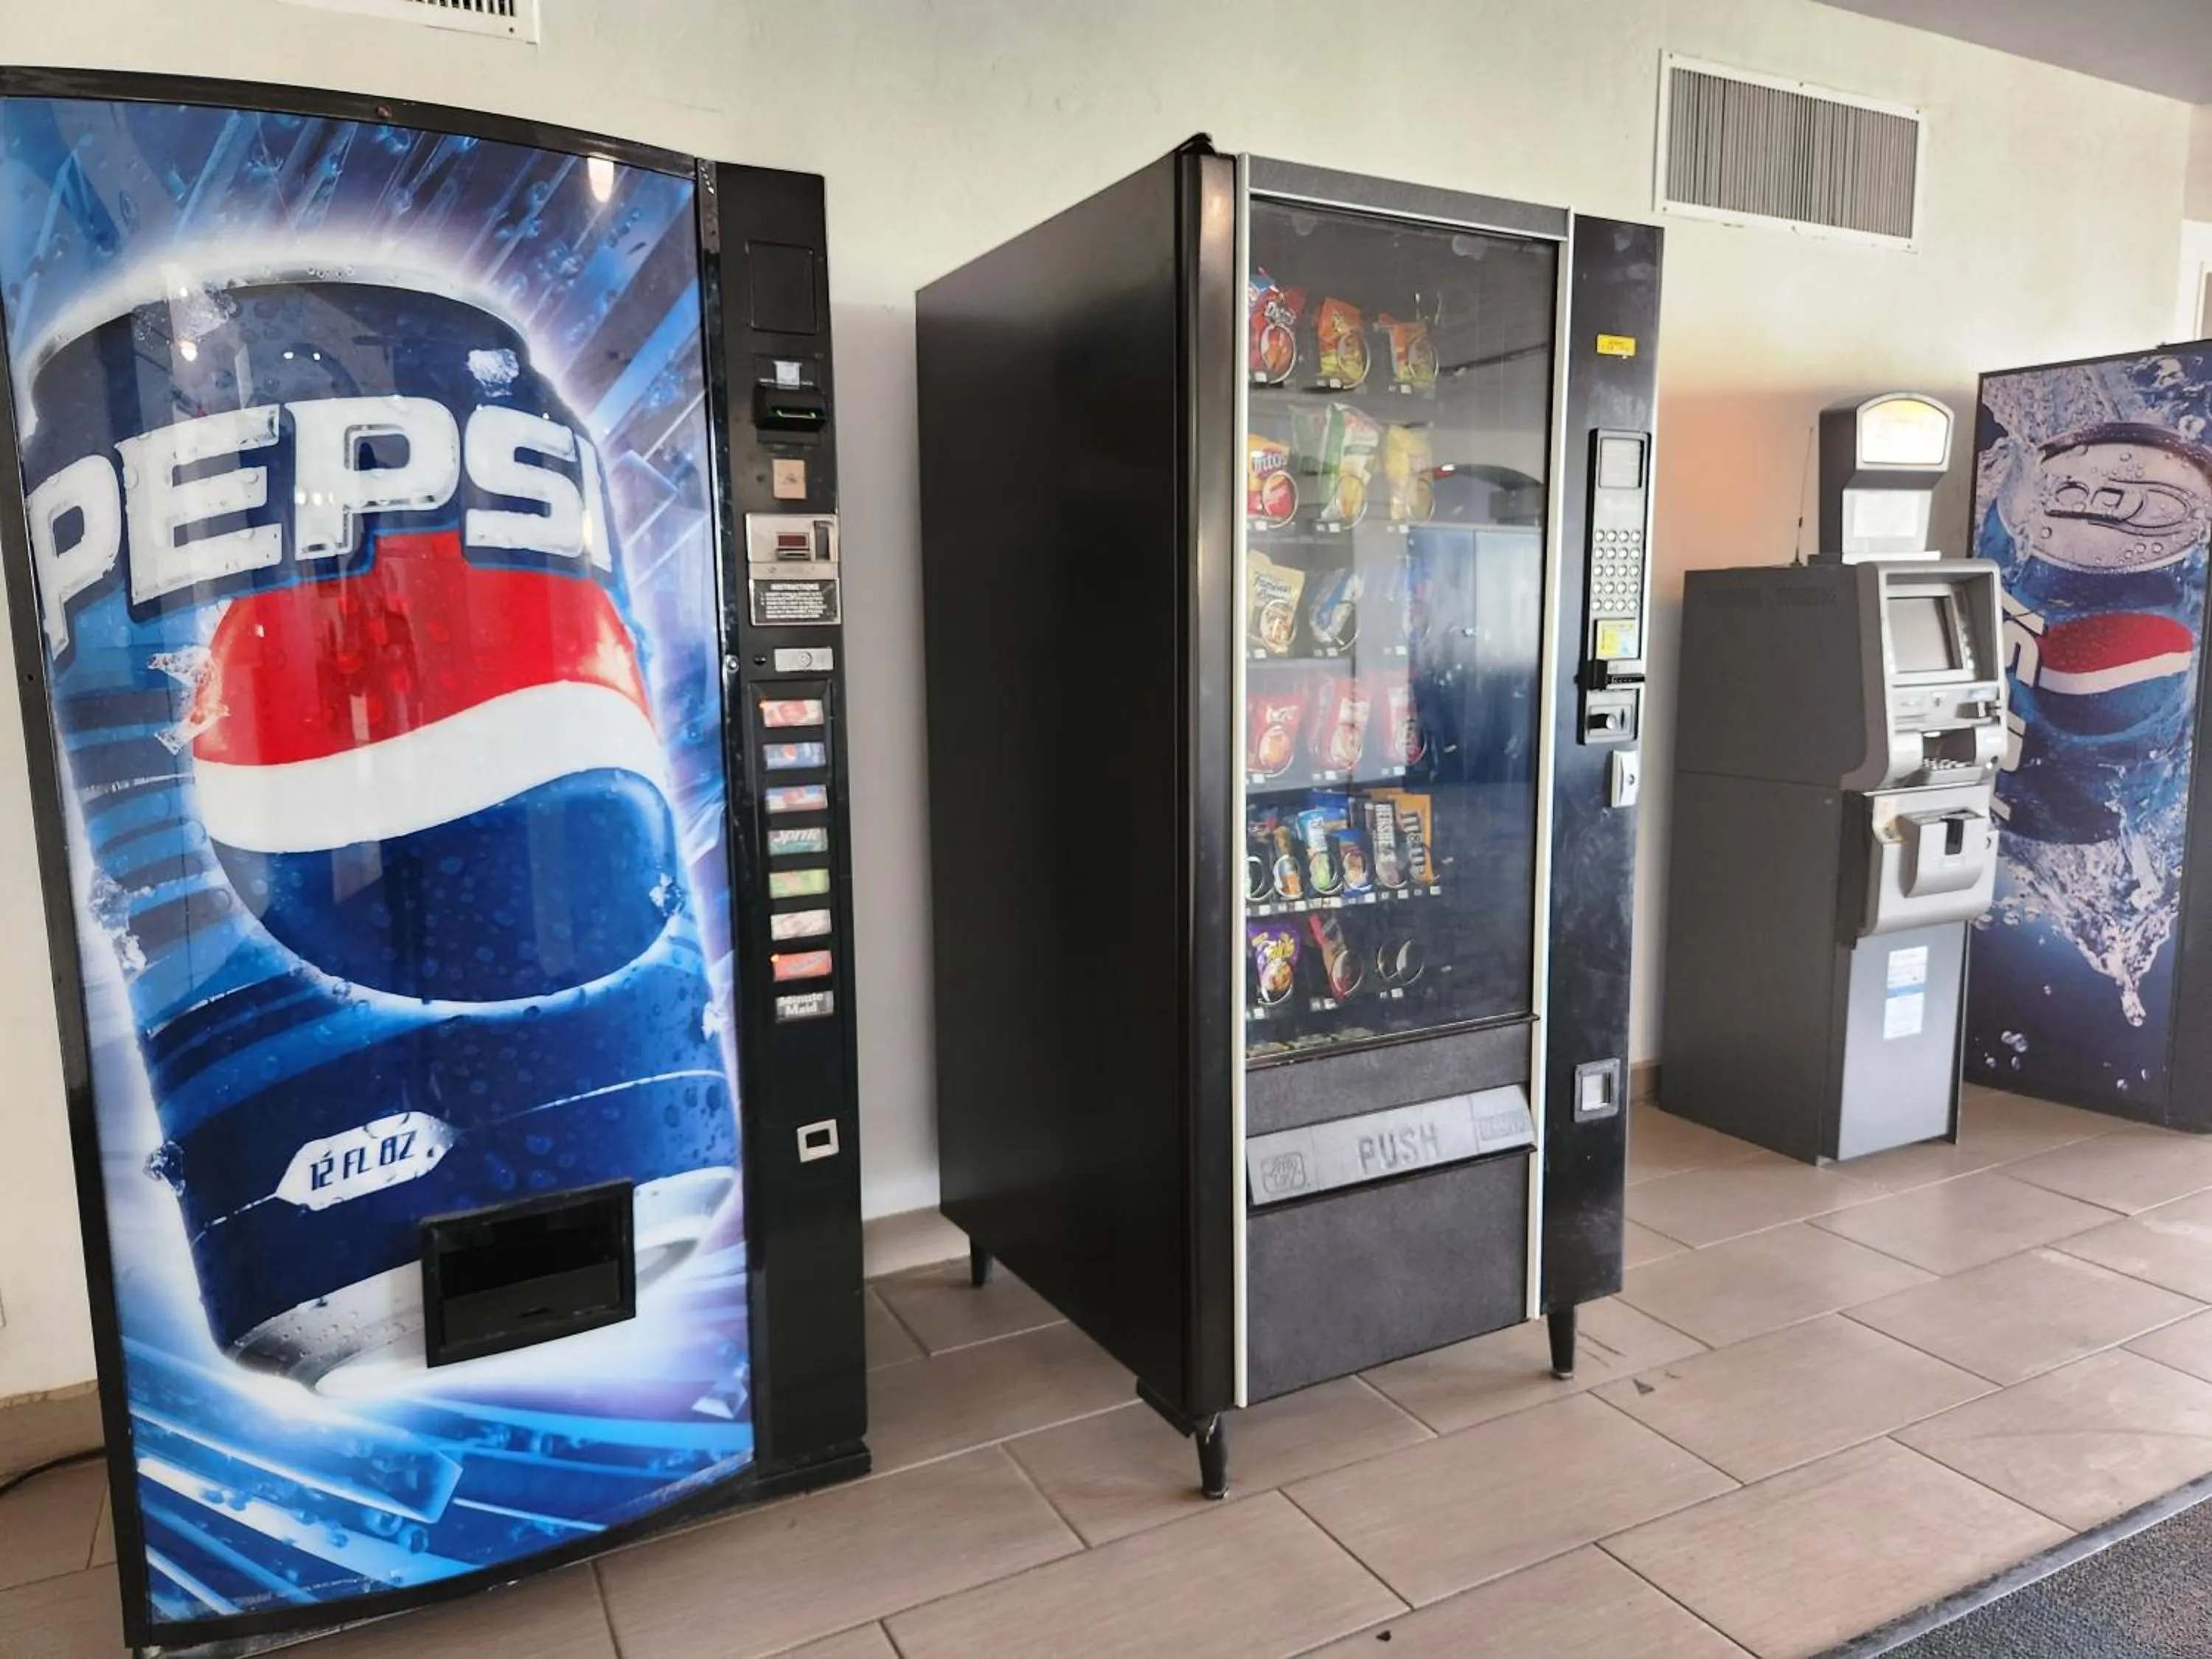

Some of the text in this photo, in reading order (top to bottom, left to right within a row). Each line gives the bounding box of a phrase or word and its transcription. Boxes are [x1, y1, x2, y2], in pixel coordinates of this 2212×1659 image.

[27, 395, 613, 659] PEPSI
[776, 992, 824, 1006] Minute
[785, 1001, 818, 1016] Maid
[309, 1153, 334, 1191] 12
[342, 1146, 372, 1180] FL
[1357, 1121, 1440, 1175] PUSH
